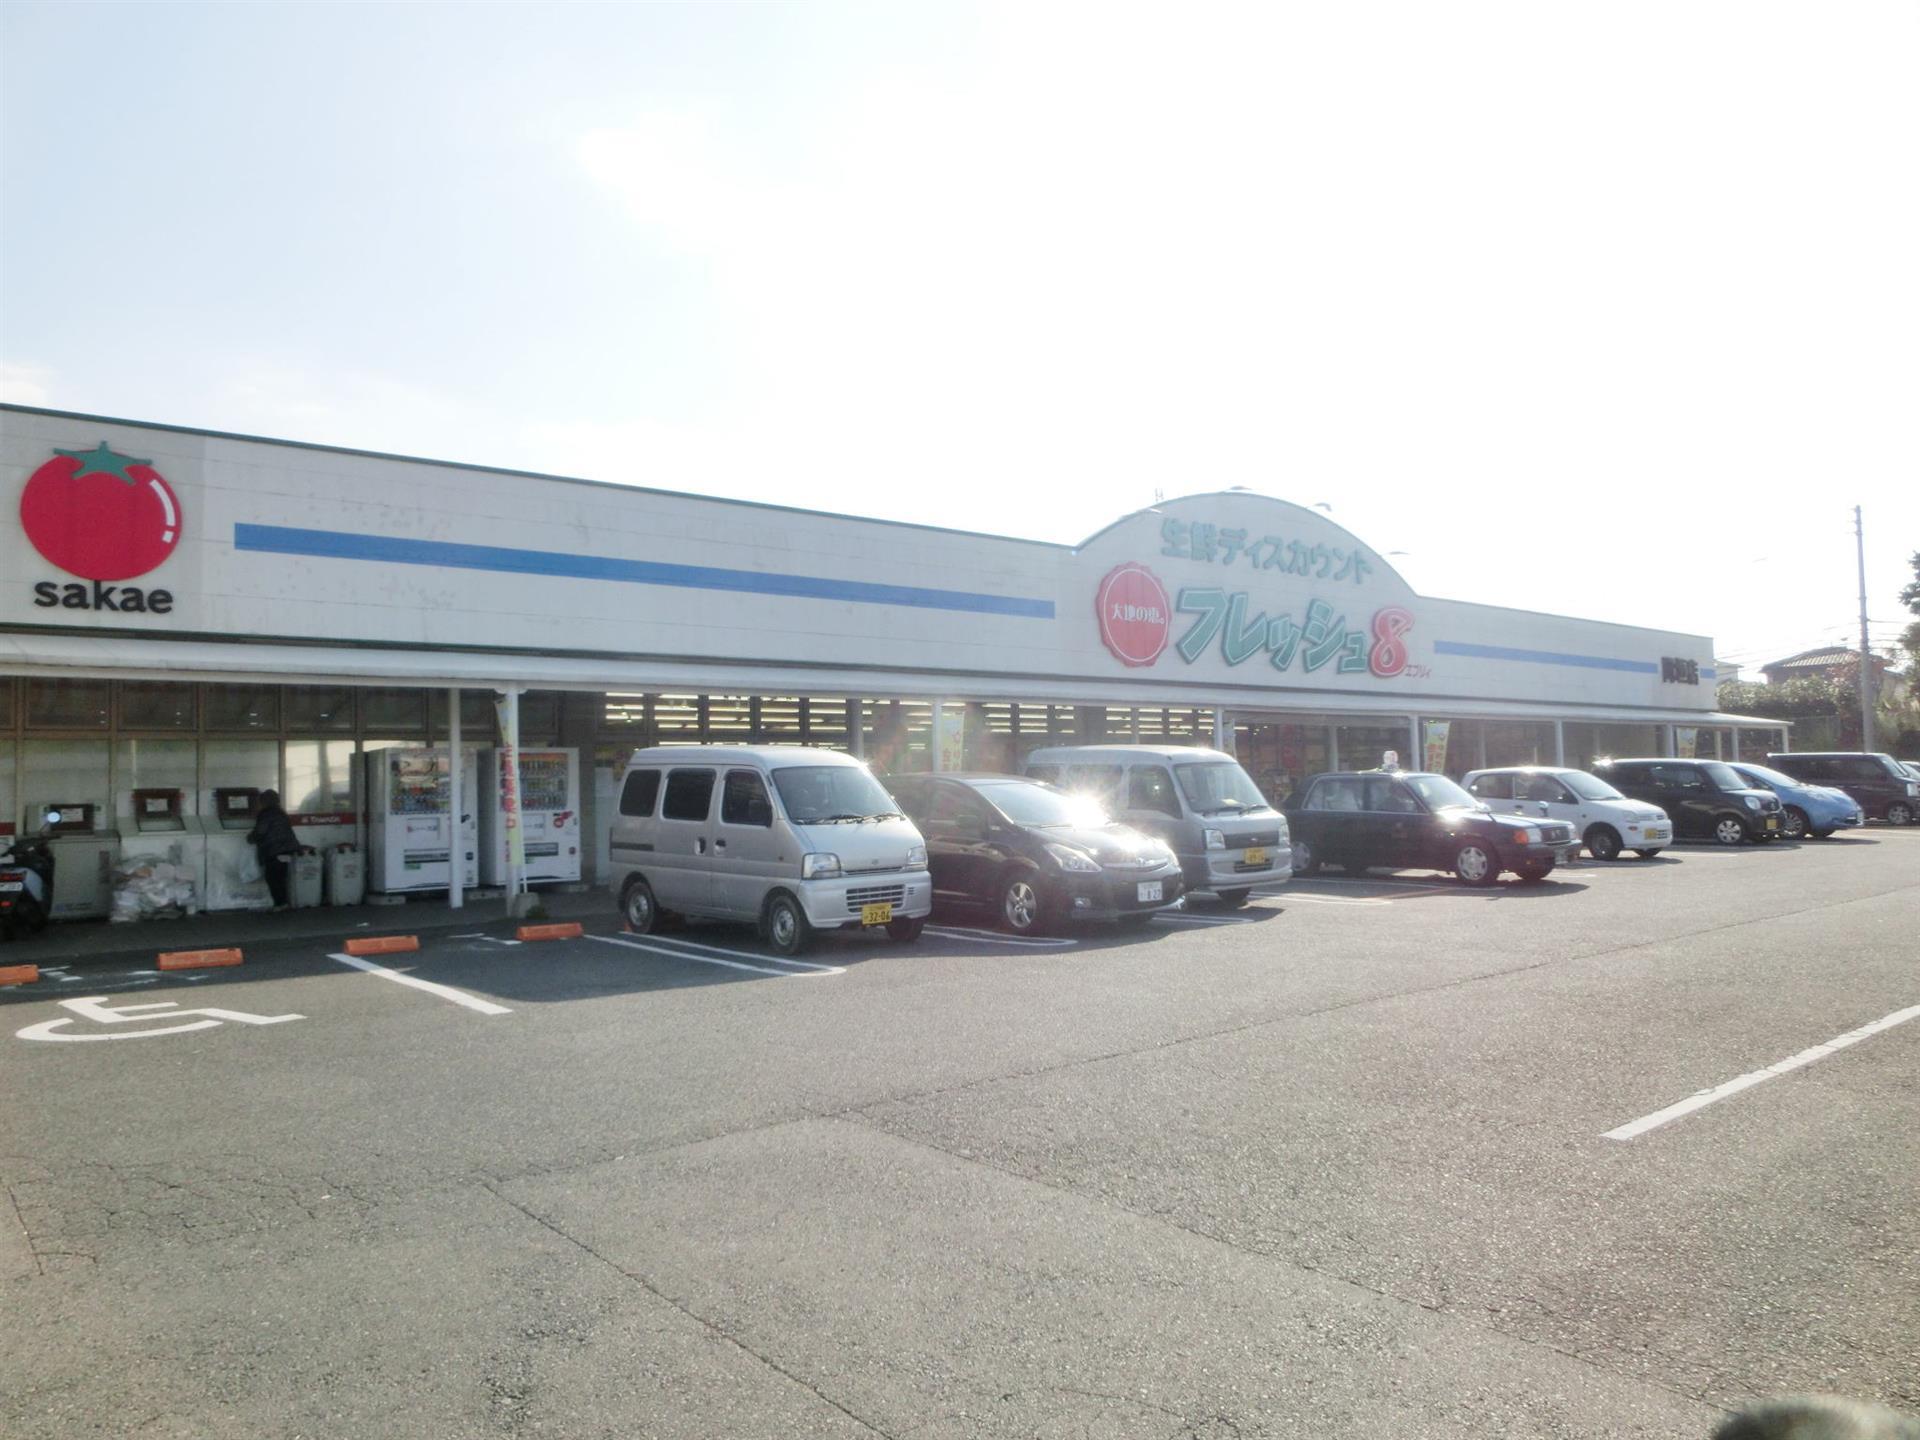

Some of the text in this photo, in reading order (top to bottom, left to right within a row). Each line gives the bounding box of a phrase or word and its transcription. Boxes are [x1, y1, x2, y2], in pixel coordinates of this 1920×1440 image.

[1161, 518, 1374, 585] 生鮮ディスカウント
[34, 580, 174, 614] sakae
